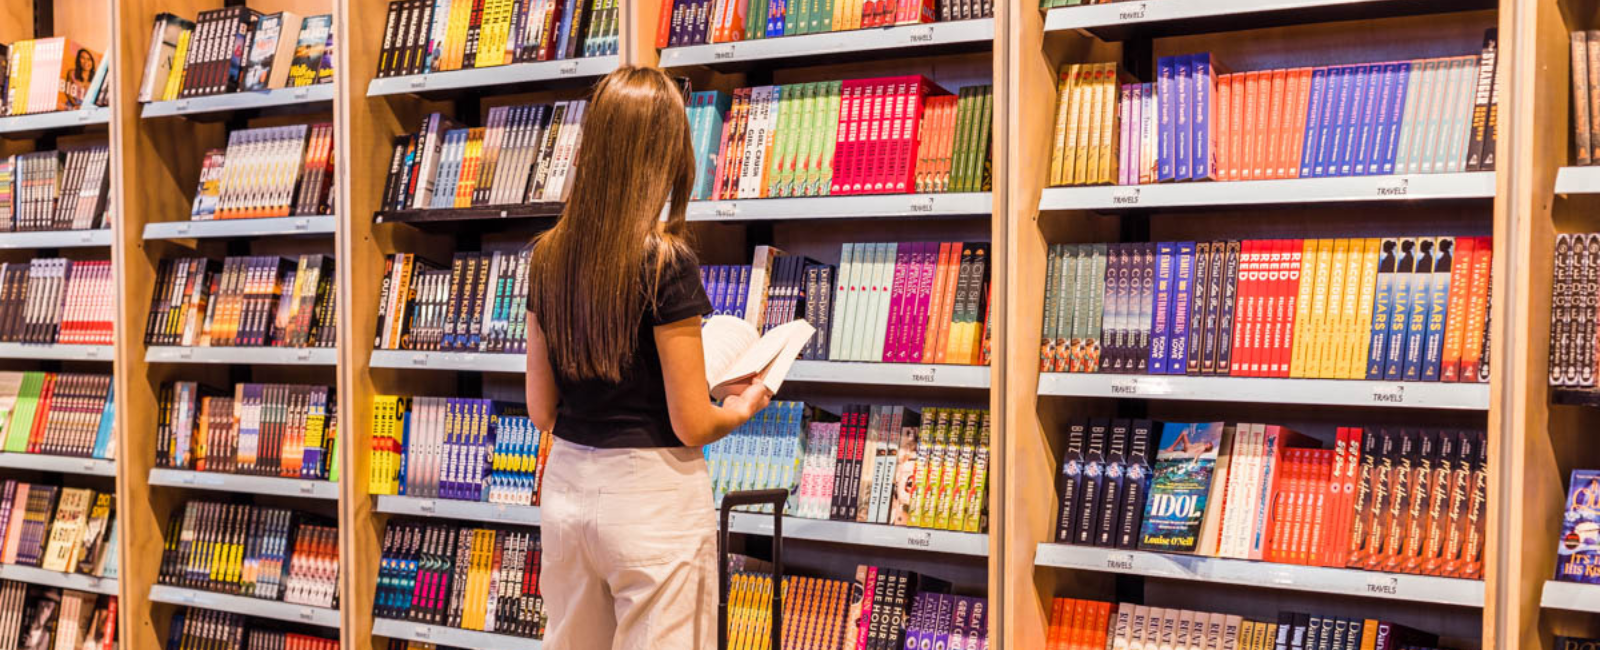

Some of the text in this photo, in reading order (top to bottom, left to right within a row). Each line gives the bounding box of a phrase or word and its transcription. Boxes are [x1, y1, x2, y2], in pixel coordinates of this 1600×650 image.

[746, 129, 754, 149] GIRL
[752, 128, 765, 177] GIRL CRUSH
[742, 151, 751, 177] CRUSH
[1377, 187, 1407, 195] TRAVELS
[1239, 253, 1249, 281] RED
[1249, 253, 1259, 281] RED
[1259, 253, 1269, 281] RED
[1269, 253, 1280, 281] RED
[1279, 253, 1291, 280] RED
[1289, 253, 1301, 280] RED
[447, 259, 463, 323] STEPHEN KING
[459, 259, 476, 323] STEPHEN KING
[472, 259, 489, 323] STEPHEN KING
[1300, 262, 1312, 315] ACCIDENT
[1315, 262, 1328, 315] ACCIDENT
[1330, 262, 1342, 315] ACCIDENT
[1345, 262, 1358, 315] ACCIDENT
[1361, 262, 1374, 315] ACCIDENT
[1556, 255, 1567, 320] LEDGE
[1571, 255, 1582, 320] LEDGE
[1586, 255, 1598, 320] LEDGE
[955, 290, 965, 314] SHIP
[967, 290, 978, 314] SHIP
[1374, 291, 1388, 331] LIARS
[1392, 291, 1406, 331] LIARS
[1411, 291, 1425, 331] LIARS
[1430, 291, 1445, 331] LIARS
[1151, 337, 1159, 358] LOWE
[1171, 338, 1179, 359] LOWE
[1111, 385, 1136, 394] TRAVELS
[1373, 393, 1403, 402] TRAVELS
[922, 412, 932, 441] MAGGIE
[937, 413, 947, 442] MAGGIE
[951, 413, 962, 442] MAGGIE
[965, 414, 976, 443] MAGGIE
[1068, 425, 1084, 453] BLITZ
[1089, 426, 1105, 454] BLITZ
[1110, 427, 1126, 455] BLITZ
[1132, 428, 1148, 456] BLITZ
[1064, 479, 1073, 499] DANIEL
[1085, 481, 1094, 500] DANIEL
[1106, 482, 1115, 502] DANIEL
[1128, 483, 1137, 503] DANIEL
[1354, 455, 1374, 513] Mad Honey
[1373, 458, 1392, 516] Mad Honey
[1391, 458, 1411, 517] Mad Honey
[1411, 459, 1431, 518] Mad Honey
[1431, 460, 1451, 519] Mad Honey
[1450, 461, 1470, 521] Mad Honey
[1150, 493, 1201, 518] IDOL
[1468, 488, 1485, 523] Honey
[1144, 535, 1170, 545] Louise
[1107, 560, 1132, 569] TRAVELS
[1367, 584, 1397, 594] TRAVELS
[869, 574, 886, 637] BLUE HOUR
[879, 576, 896, 639] BLUE HOUR
[889, 577, 907, 640] BLUE HOUR
[956, 600, 968, 627] GREAT
[971, 602, 983, 628] GREAT
[1117, 612, 1129, 638] RUNT
[1132, 615, 1144, 640] RUNT
[1147, 617, 1160, 643] RUNT
[1161, 618, 1174, 644] RUNT
[1177, 620, 1190, 646] RUNT
[1191, 621, 1204, 647] RUNT
[1207, 623, 1220, 649] RUNT
[1223, 625, 1237, 650] RUNT
